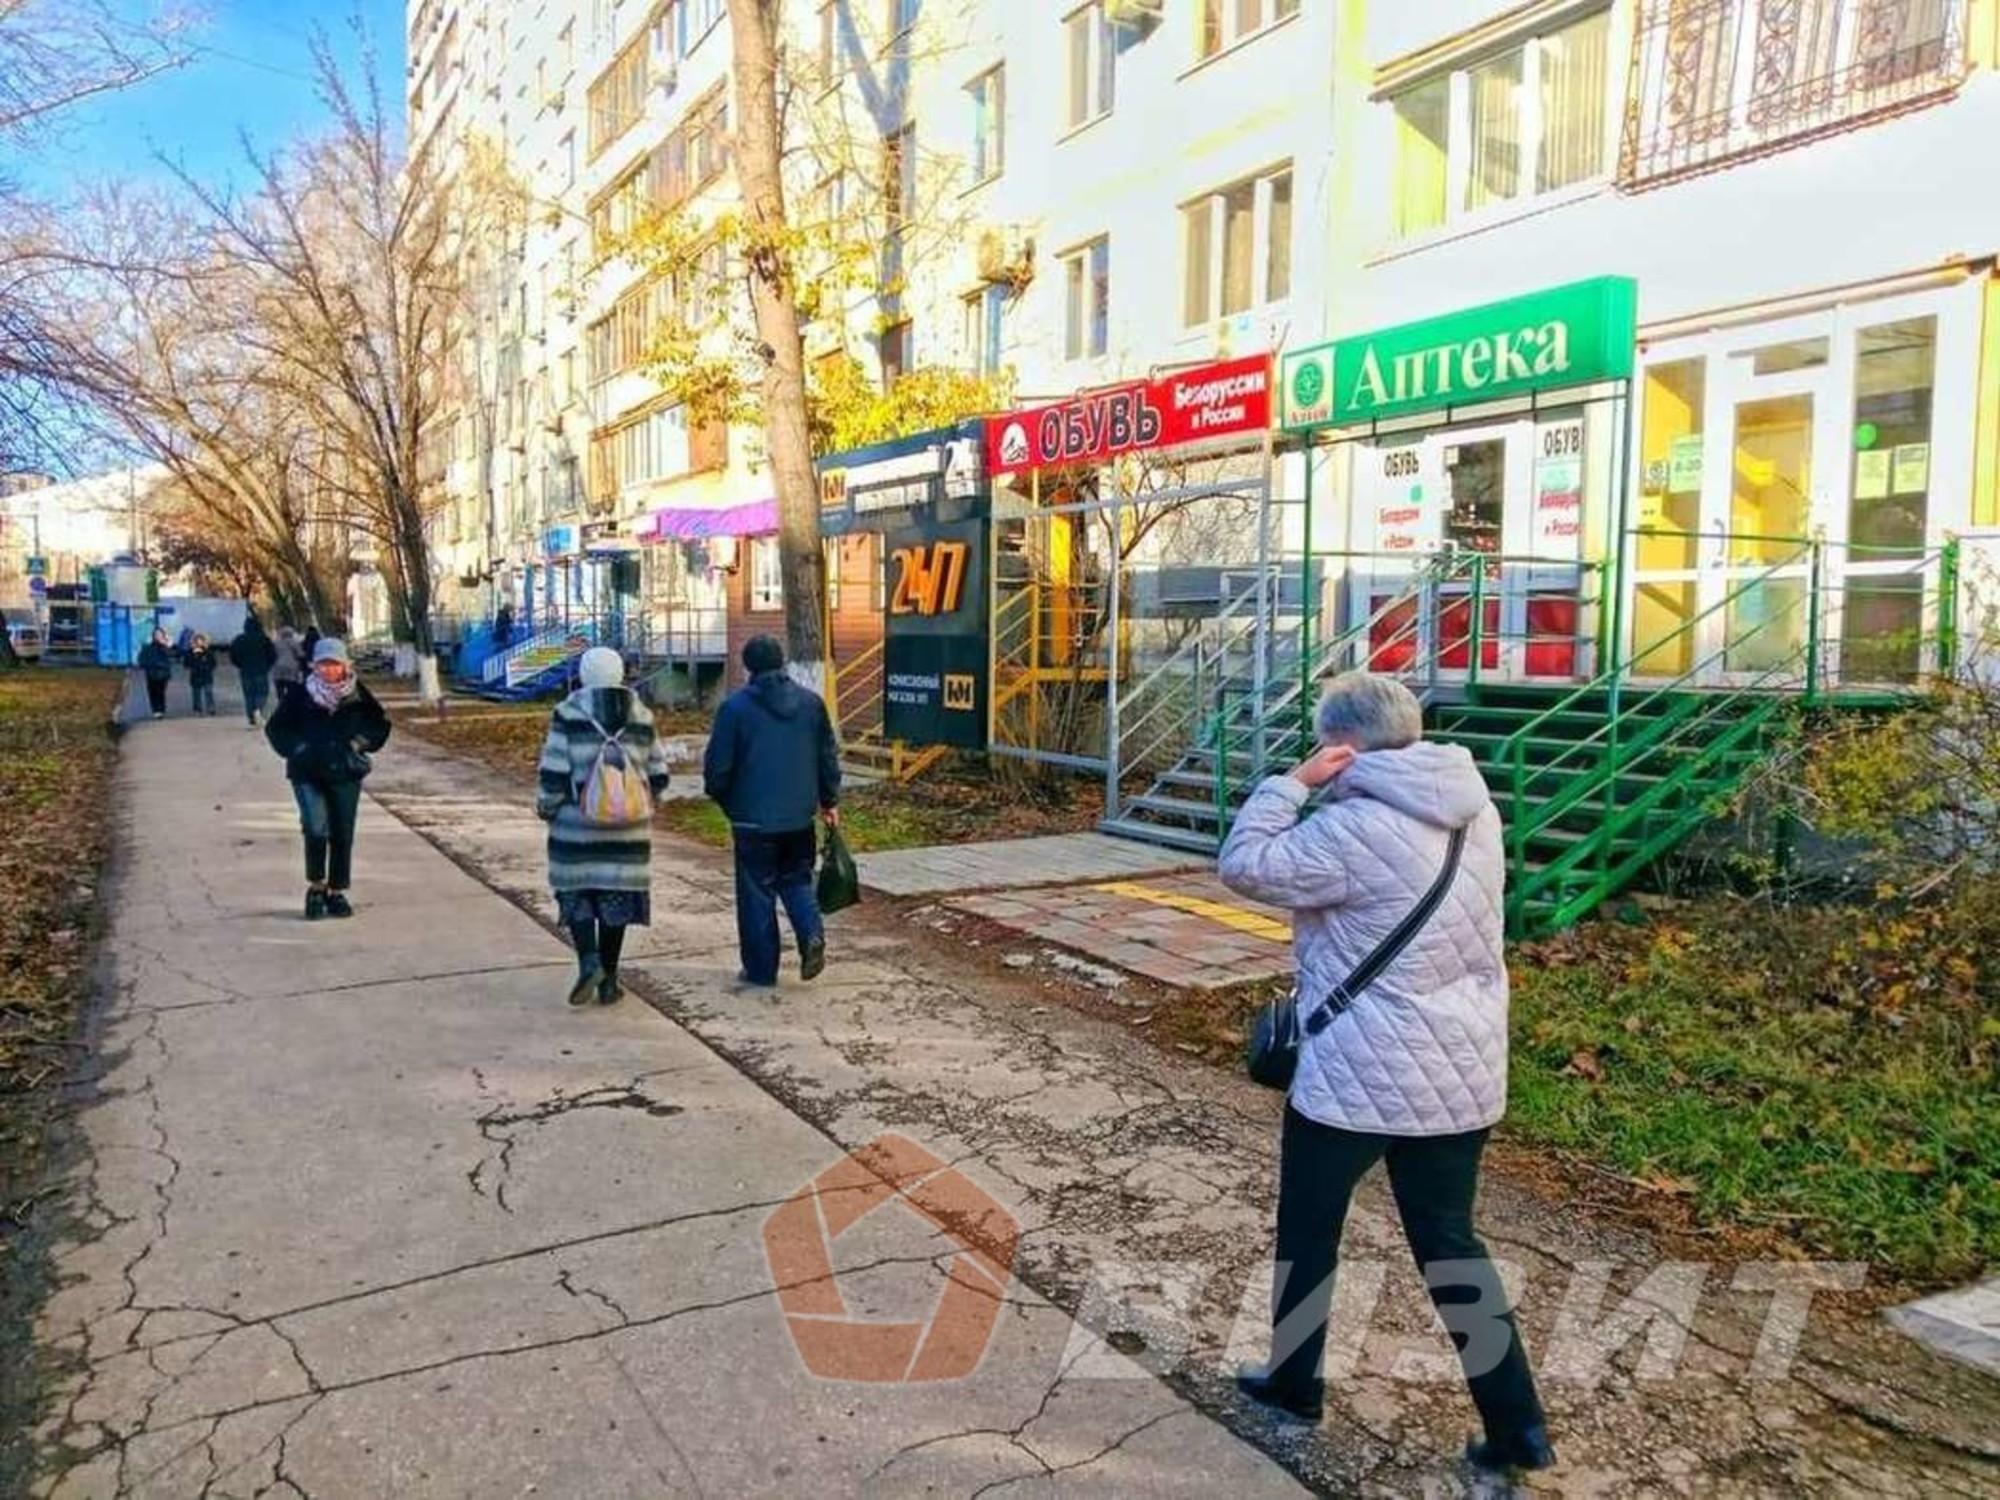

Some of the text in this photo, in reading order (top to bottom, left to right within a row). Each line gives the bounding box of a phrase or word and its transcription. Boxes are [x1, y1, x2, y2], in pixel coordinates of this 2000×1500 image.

[1174, 371, 1264, 409] Белоруссии
[1347, 319, 1571, 411] Аптека
[1040, 388, 1161, 461] ОБУВЬ
[1191, 404, 1245, 429] и России
[1384, 451, 1419, 477] ОБУВЬ
[891, 541, 967, 616] 24/7
